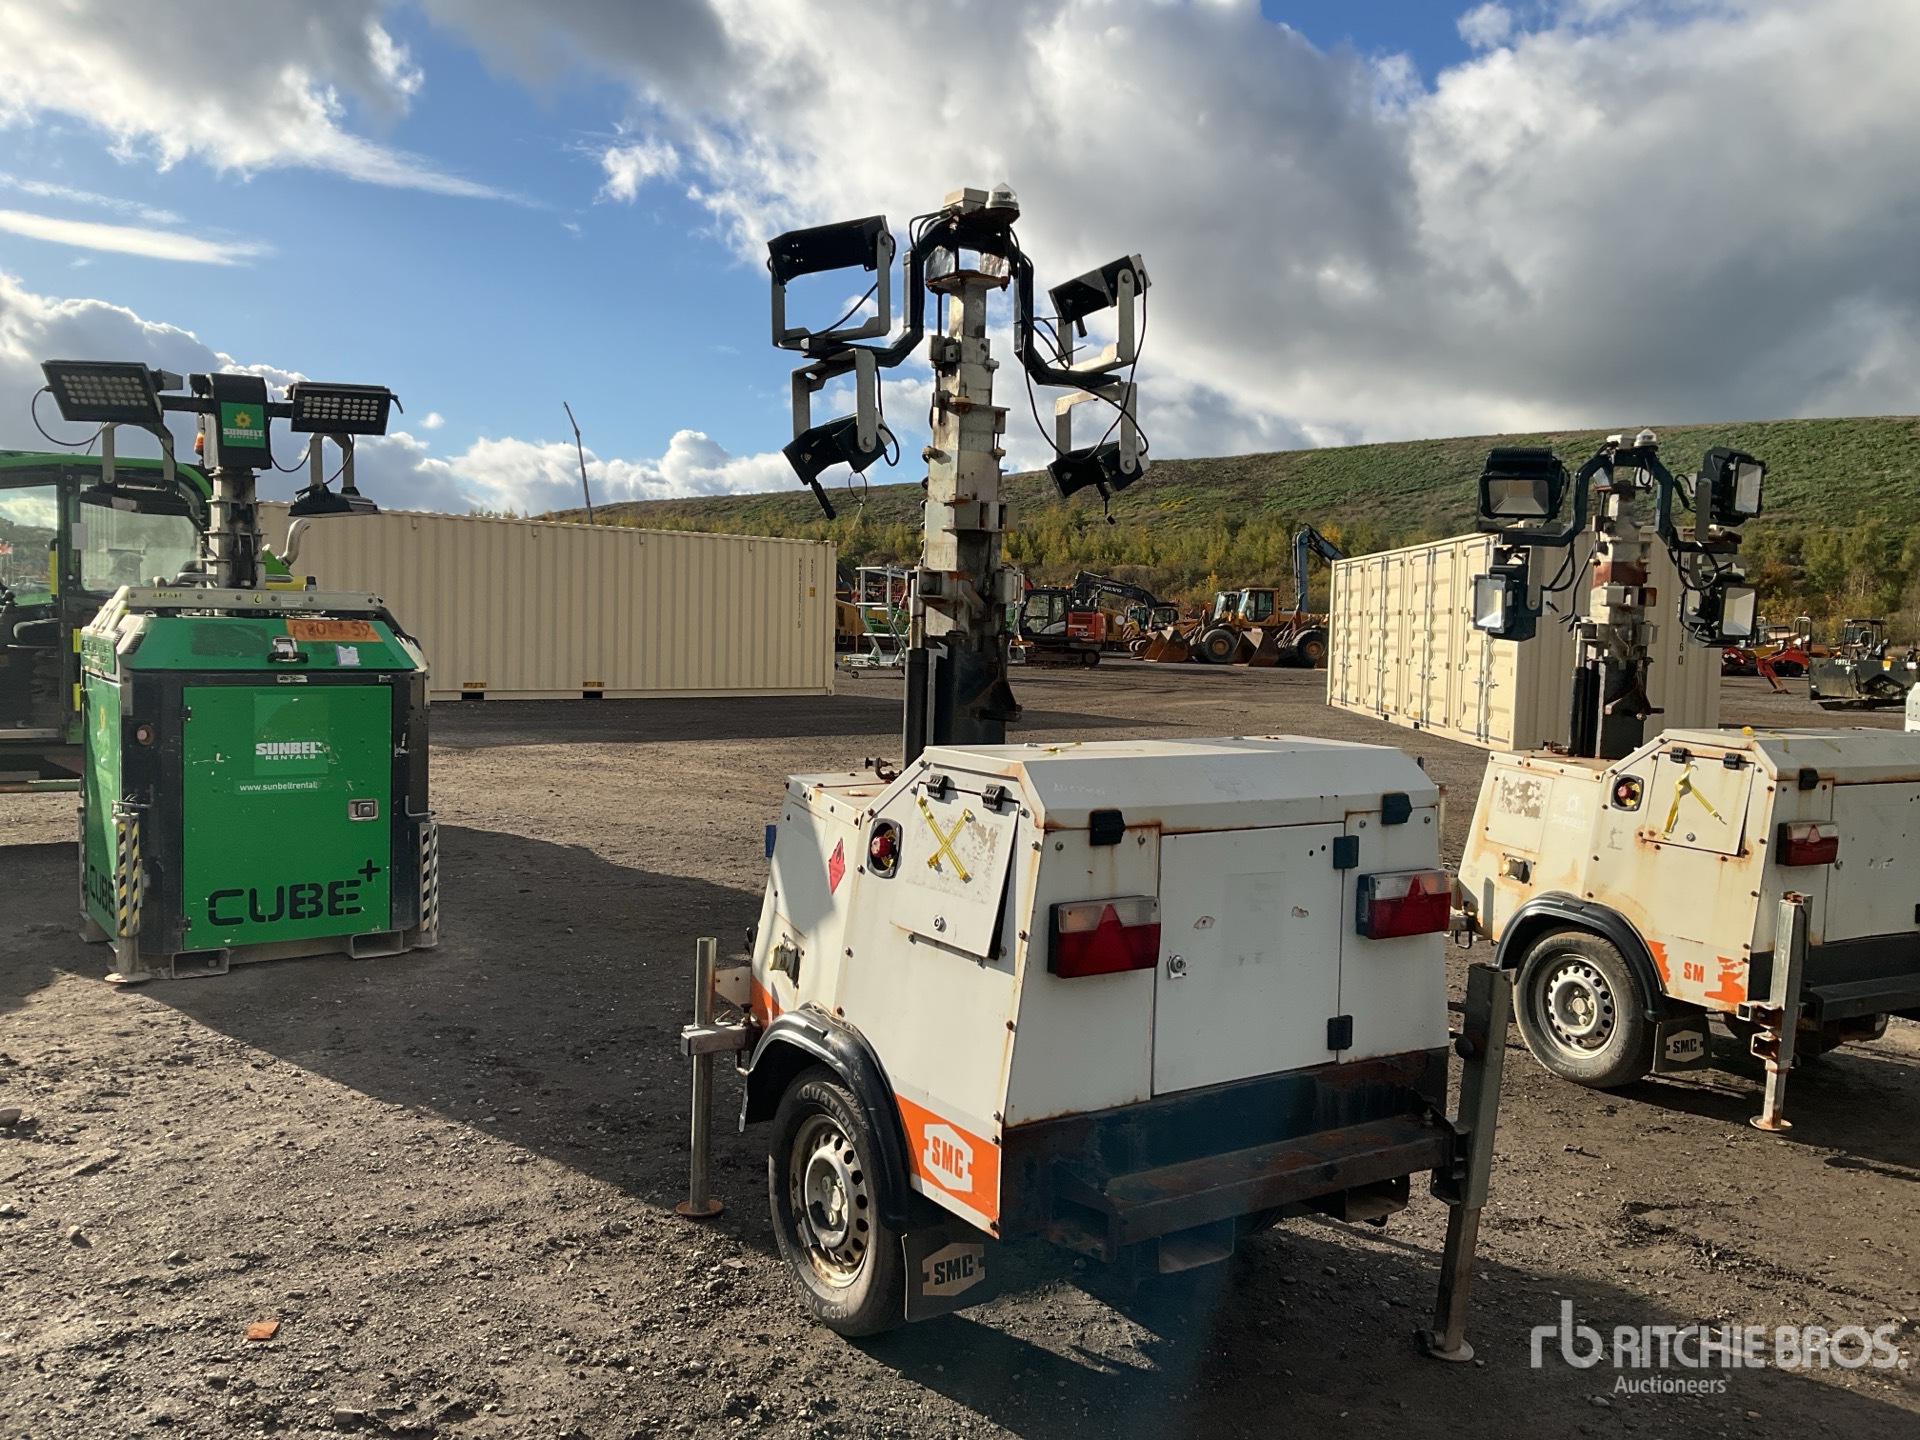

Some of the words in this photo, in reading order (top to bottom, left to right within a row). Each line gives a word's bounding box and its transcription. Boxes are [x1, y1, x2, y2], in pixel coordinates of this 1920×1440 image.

[1683, 961, 1705, 983] SM
[1673, 1038, 1697, 1054] SMC
[931, 1136, 964, 1179] SMC
[934, 1254, 974, 1286] SMC
